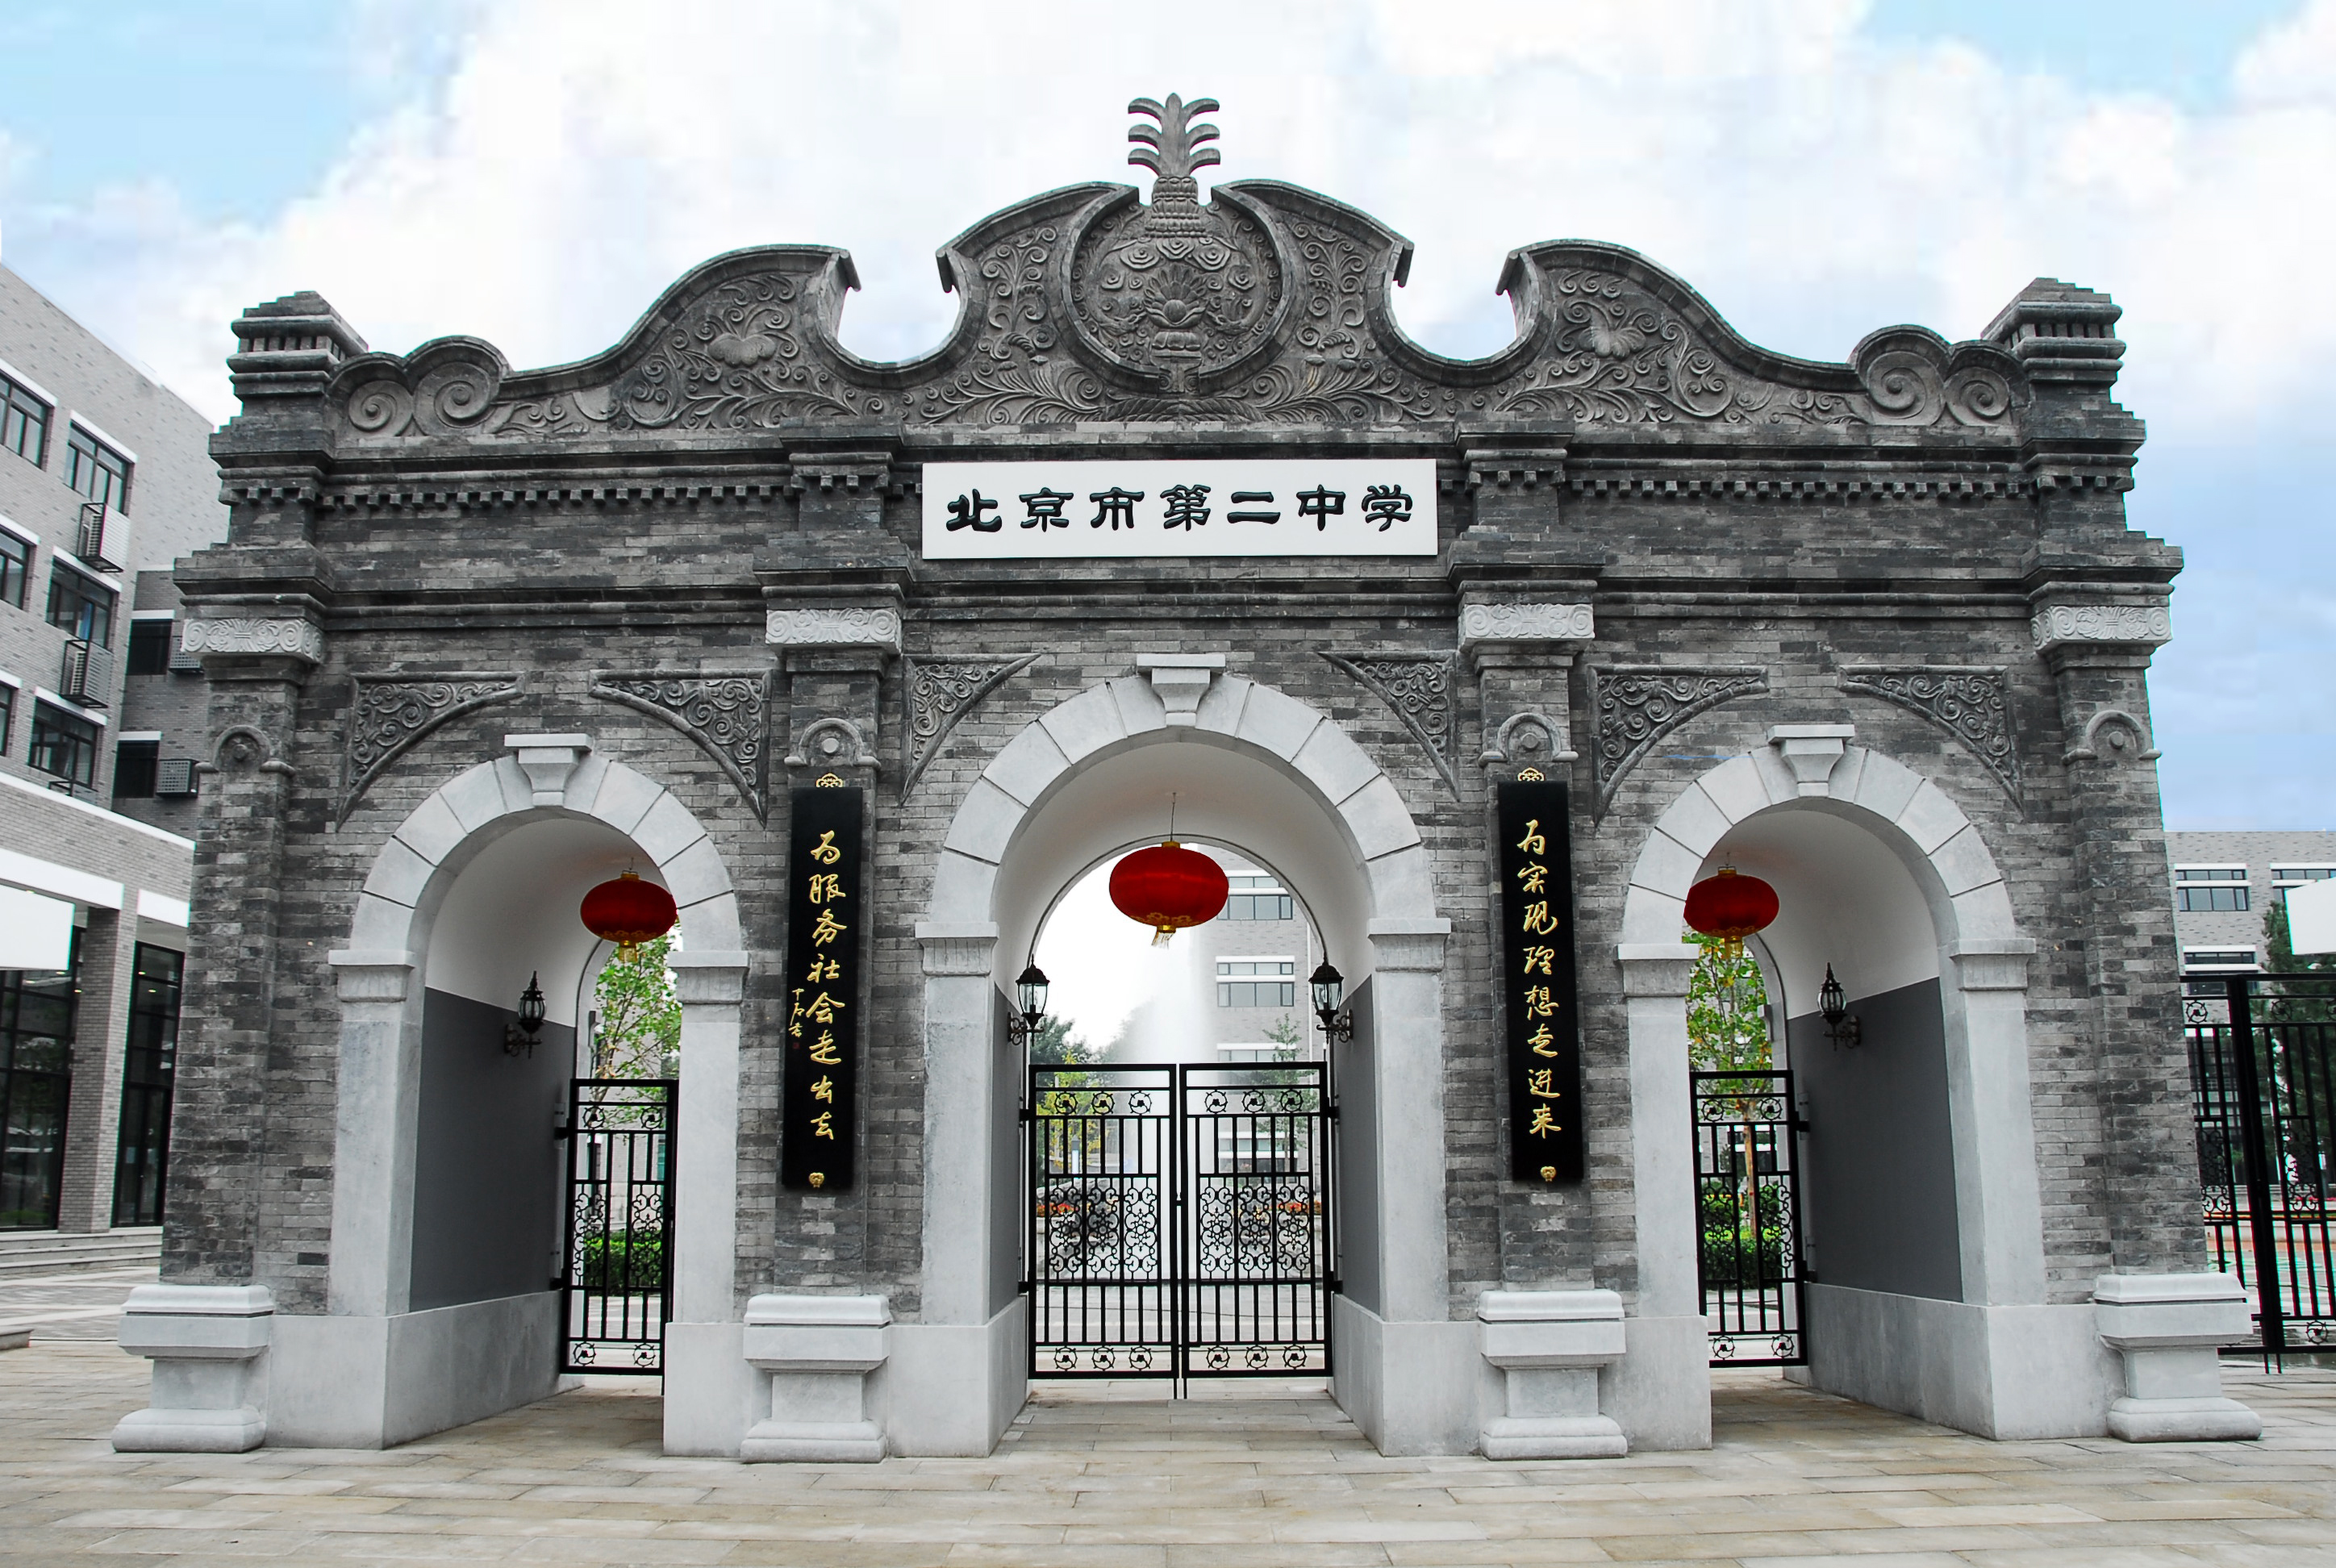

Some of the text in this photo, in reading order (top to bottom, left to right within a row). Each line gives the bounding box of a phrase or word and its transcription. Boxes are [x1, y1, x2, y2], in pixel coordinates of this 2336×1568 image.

[945, 484, 1413, 533] 北京市第二中学
[806, 829, 847, 1141] 为服务社会走出去
